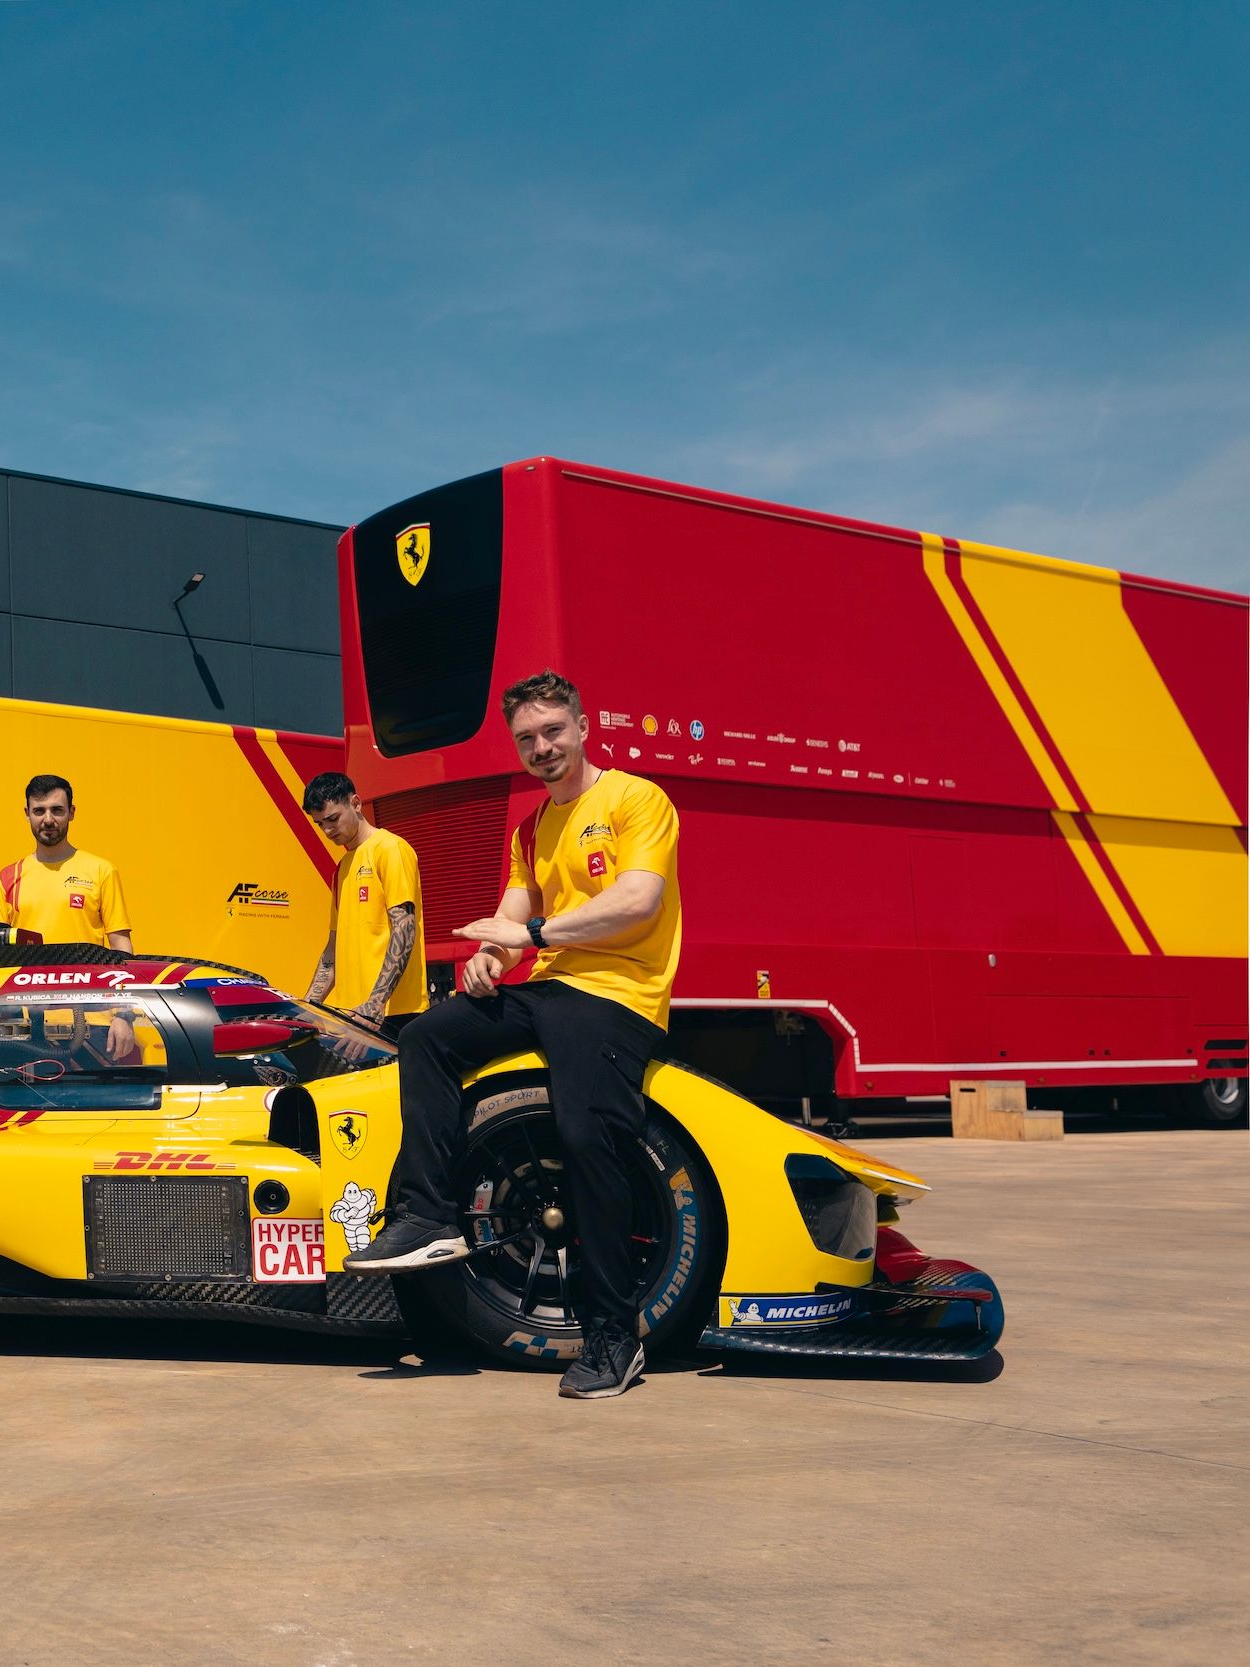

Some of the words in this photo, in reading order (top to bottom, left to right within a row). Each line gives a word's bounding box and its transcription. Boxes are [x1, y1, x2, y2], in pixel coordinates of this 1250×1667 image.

[13, 972, 91, 986] ORLEN
[474, 1100, 502, 1119] PILOT
[504, 1090, 541, 1104] SPORT
[113, 1151, 217, 1170] DHL
[258, 1223, 324, 1243] HYPER
[259, 1243, 326, 1276] CAR
[651, 1213, 697, 1321] MICHELIN
[766, 1297, 852, 1319] MICHELIN
